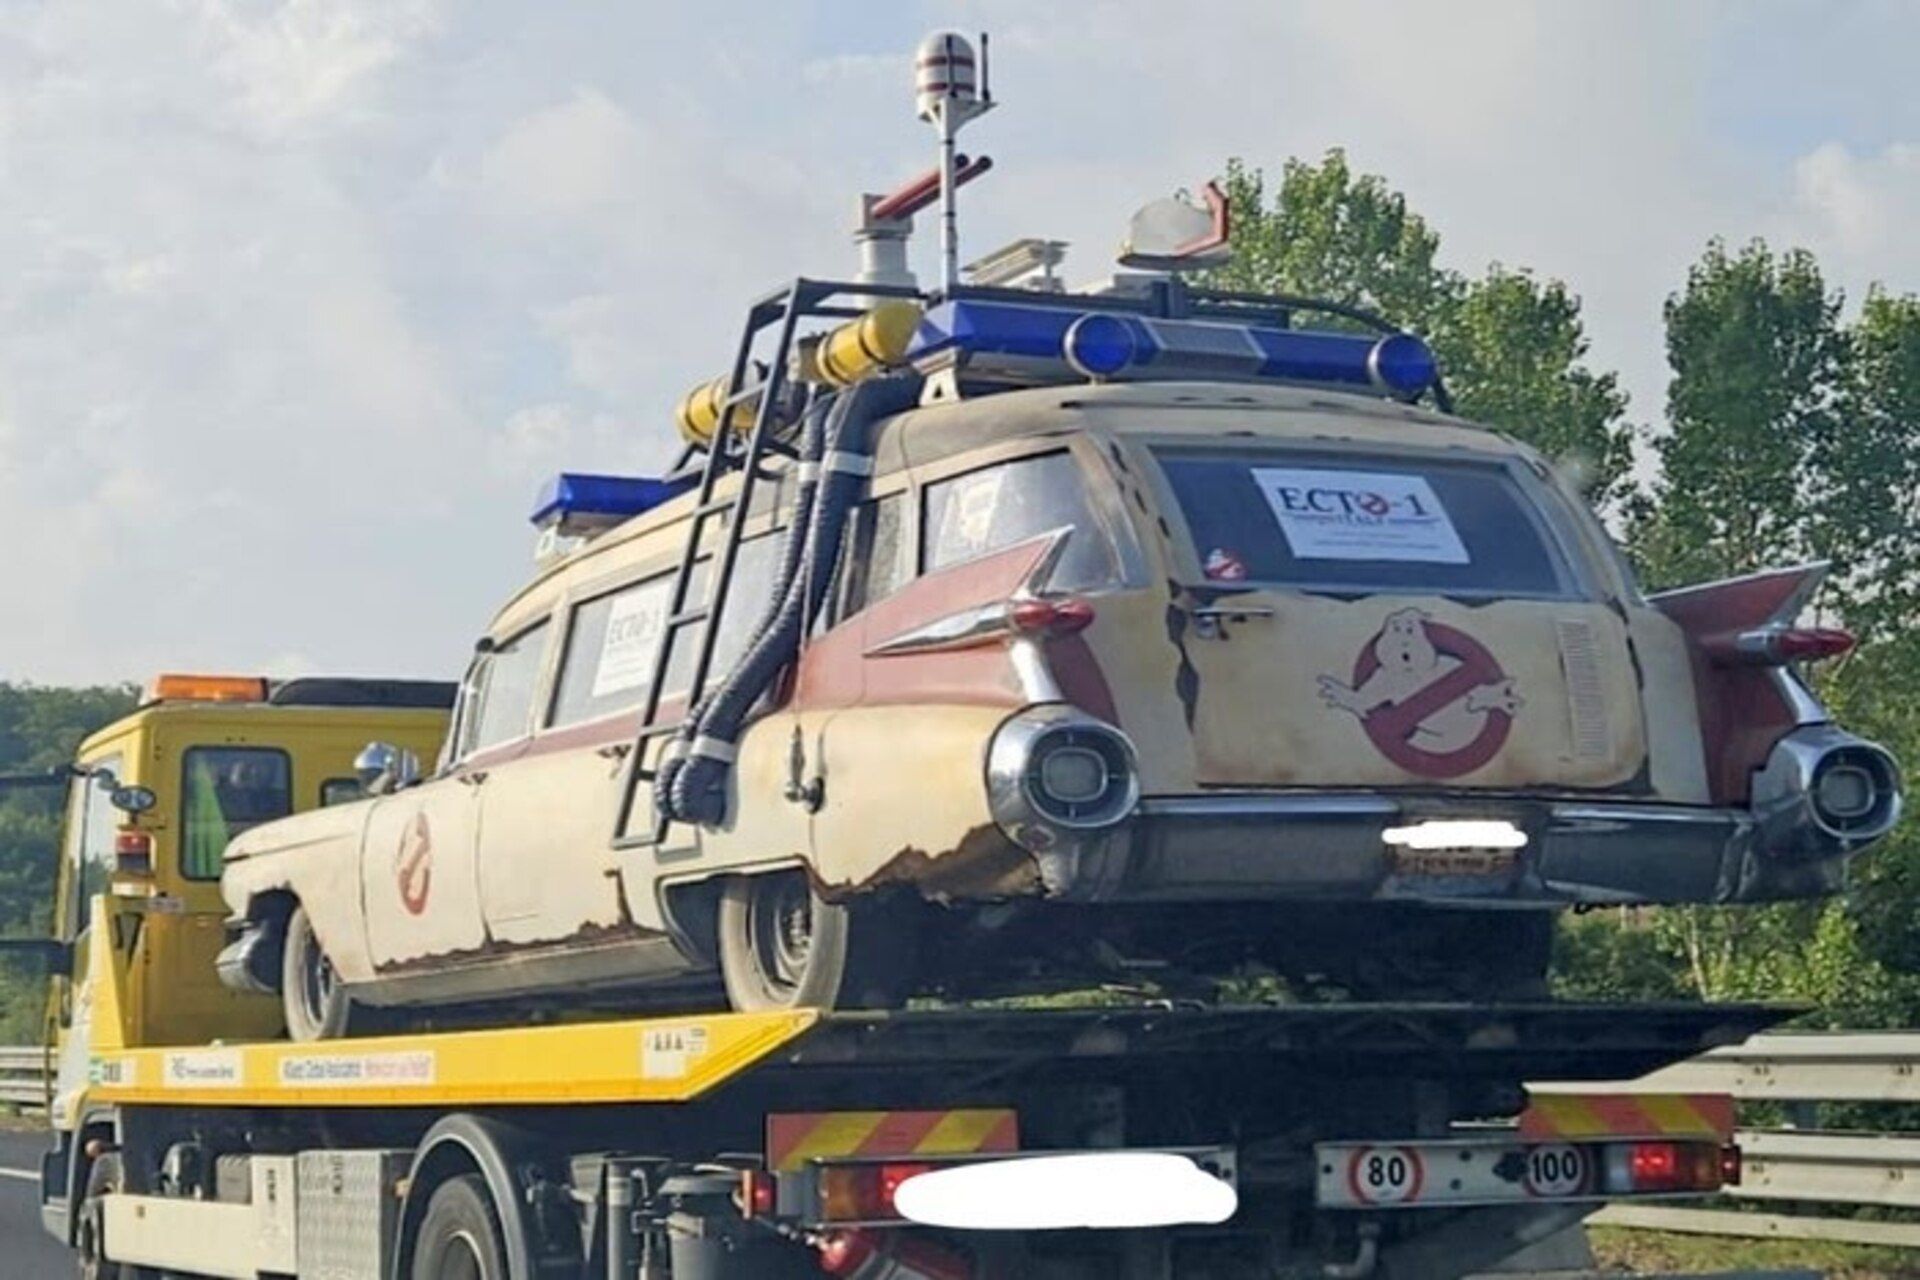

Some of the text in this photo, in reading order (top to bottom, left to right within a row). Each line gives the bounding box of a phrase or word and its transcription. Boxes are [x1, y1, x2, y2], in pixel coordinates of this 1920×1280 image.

[1277, 486, 1428, 516] ECTO-1
[1367, 1156, 1406, 1187] 80
[1532, 1151, 1579, 1183] 100
